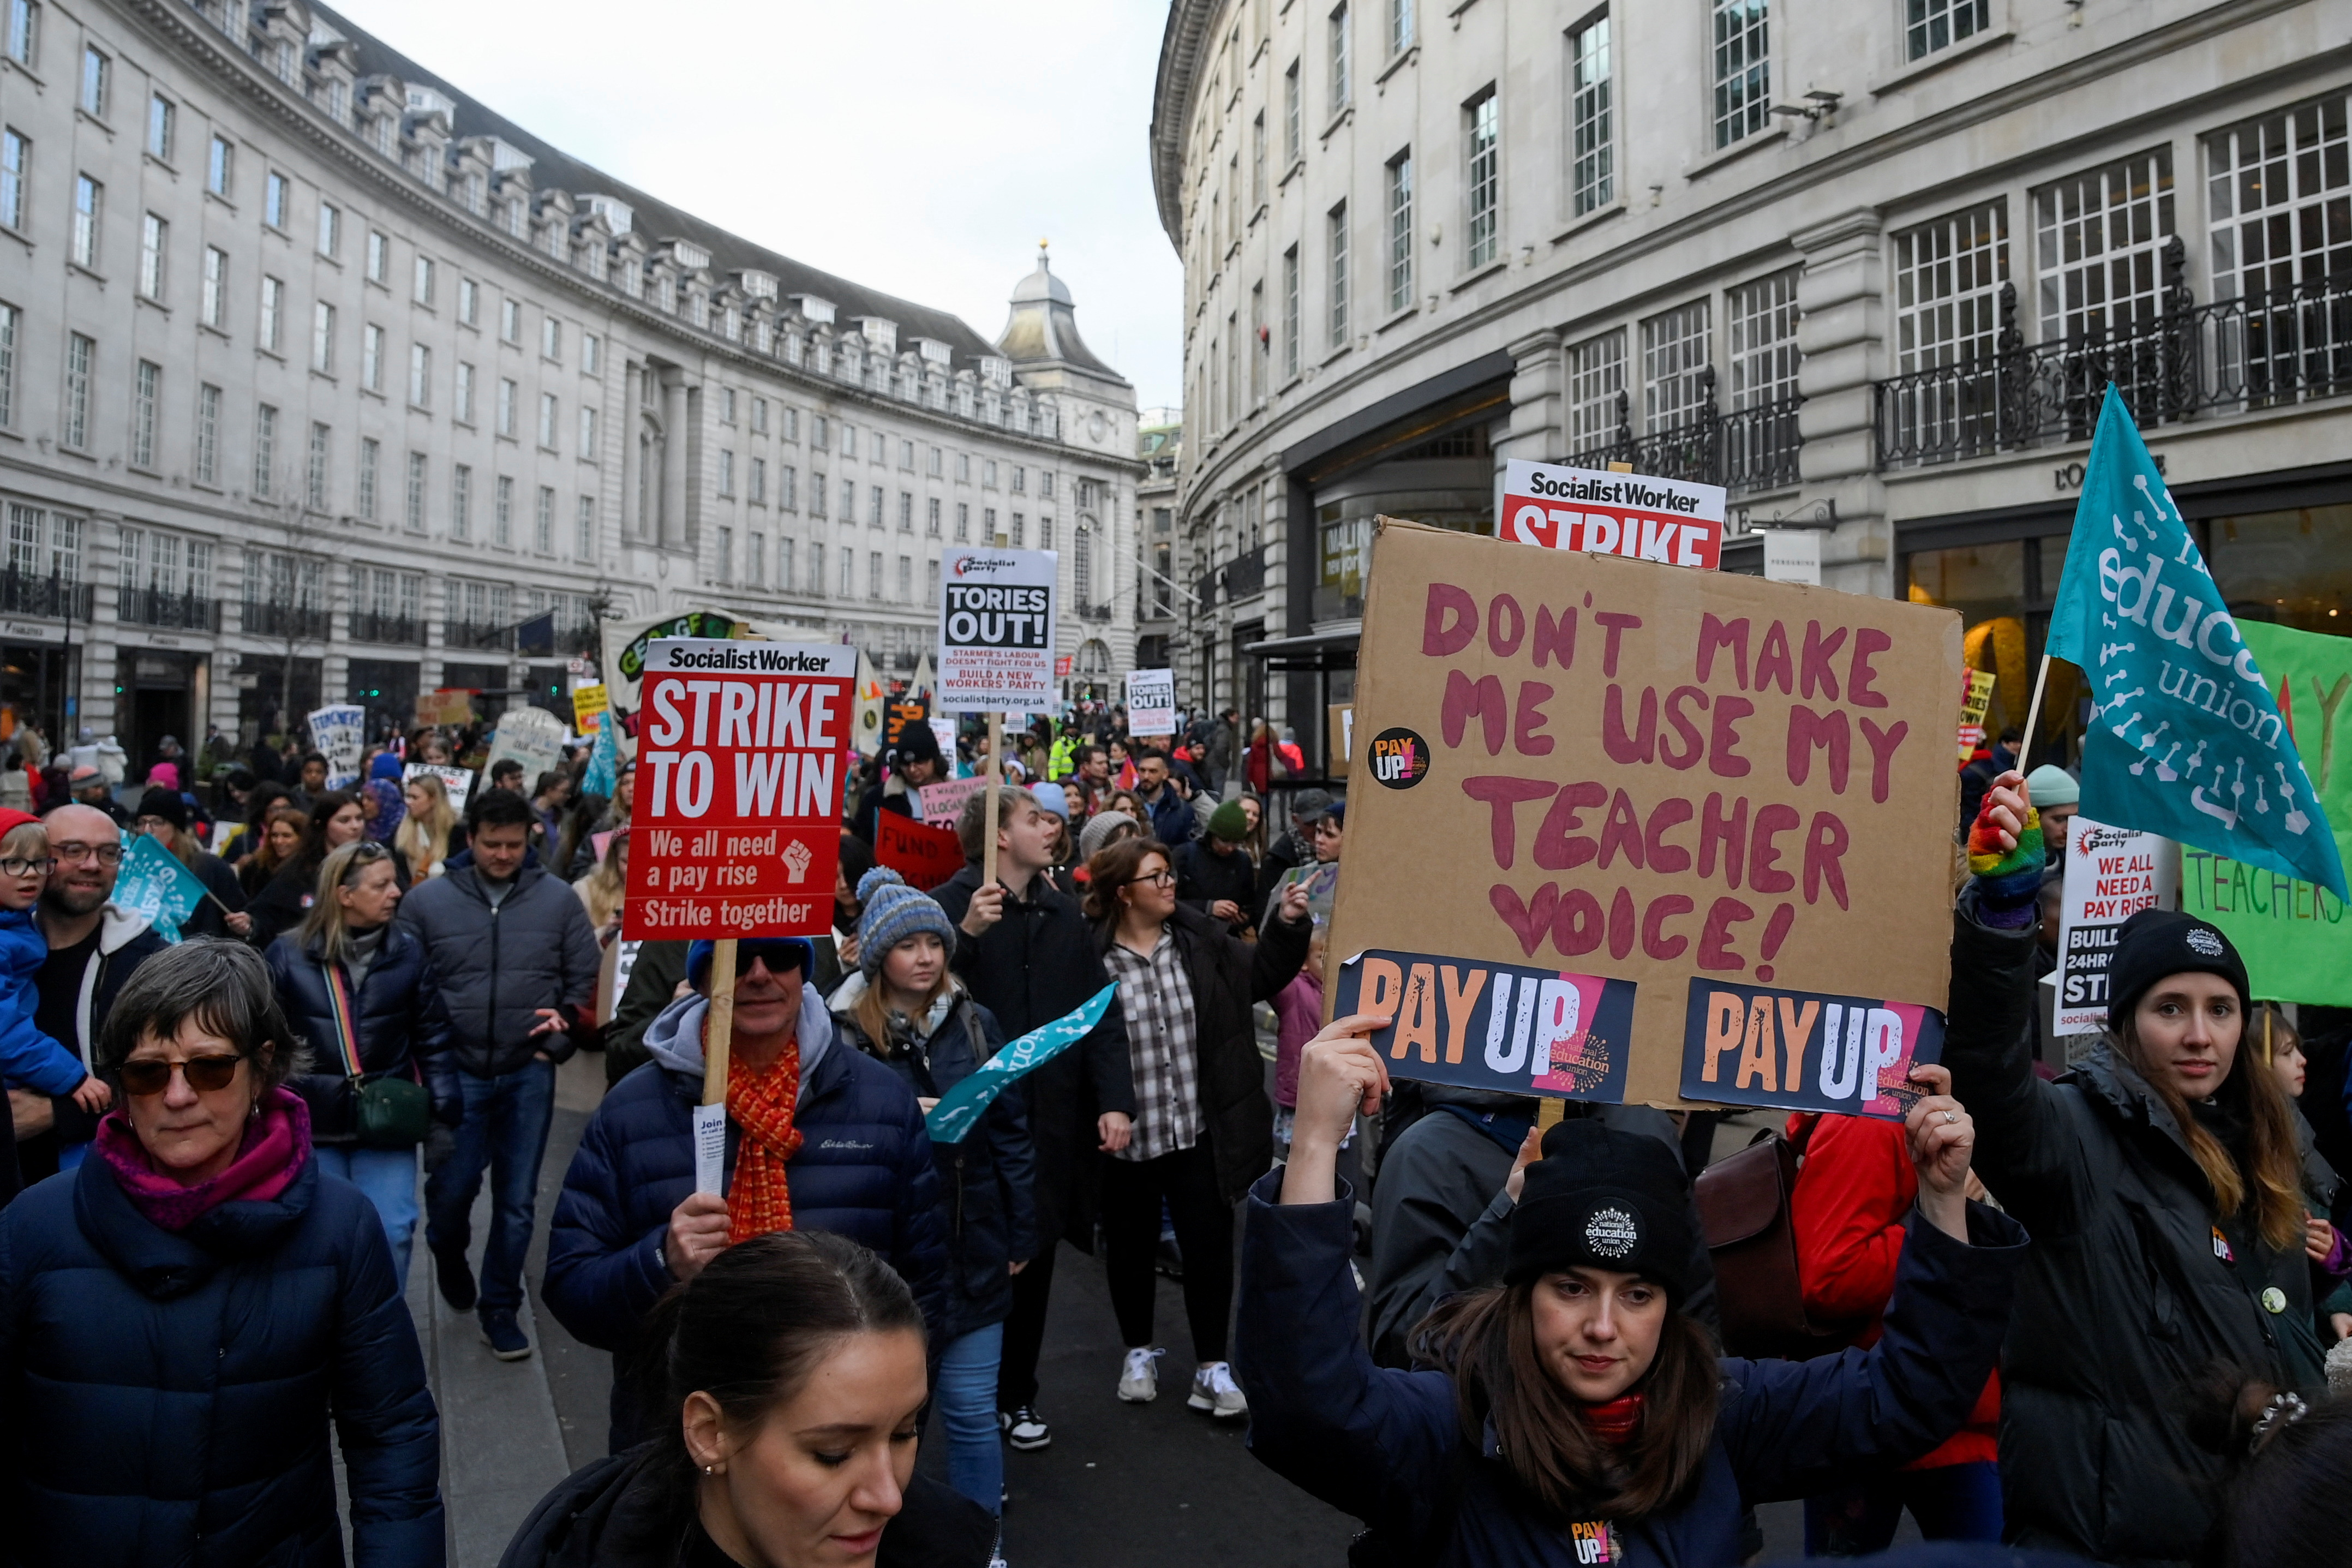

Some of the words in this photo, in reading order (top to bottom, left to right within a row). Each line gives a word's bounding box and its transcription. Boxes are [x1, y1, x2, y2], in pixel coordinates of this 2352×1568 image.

[1530, 472, 1622, 502] Socialist
[1625, 482, 1699, 513] Worker
[968, 556, 1015, 566] Socialist
[948, 587, 1046, 612] TORIES
[948, 611, 1045, 645] OUT!
[953, 649, 1002, 658] STARMER'S
[1004, 650, 1040, 659] LABOUR
[1421, 583, 1642, 678] DON'T
[1696, 612, 1892, 708] MAKE
[669, 647, 756, 669] Socialist
[760, 649, 830, 672] Worker
[945, 679, 1006, 689] WORKERS'
[1009, 681, 1046, 690] PARTY
[959, 670, 993, 679] BUILD
[1007, 672, 1033, 680] NEW
[649, 678, 840, 748] STRIKE
[943, 694, 1045, 707] socialistparty.org.uk
[1132, 695, 1170, 709] OUT!
[2158, 659, 2283, 750] union
[1375, 737, 1413, 757] PAY
[1440, 669, 1555, 757] ME
[1602, 683, 1755, 778] USE
[1786, 704, 1908, 804] MY
[645, 751, 714, 818] TO
[734, 752, 835, 817] WIN
[650, 830, 683, 857] We
[691, 830, 719, 857] all
[726, 829, 777, 857] need
[882, 827, 938, 860] FUND
[1462, 775, 1849, 911] TEACHER
[2093, 828, 2142, 840] Socialist
[647, 866, 660, 886] a
[669, 865, 709, 892] pay
[716, 859, 757, 885] rise
[2098, 857, 2124, 875] WE
[2128, 854, 2154, 873] ALL
[2096, 877, 2139, 896] NEED
[2142, 875, 2152, 891] A
[644, 899, 711, 926] Strike
[720, 897, 812, 930] together
[2084, 900, 2117, 919] PAY
[1489, 882, 1794, 982] VOICE!
[1354, 957, 1487, 1064] PAY
[1567, 1042, 1597, 1057] national
[1702, 991, 1820, 1092] PAY
[1550, 1046, 1609, 1074] education
[1565, 1063, 1588, 1076] union
[1892, 1088, 1912, 1100] union
[701, 1118, 722, 1129] Join
[1585, 1226, 1637, 1240] education
[1571, 1521, 1603, 1540] PAY
